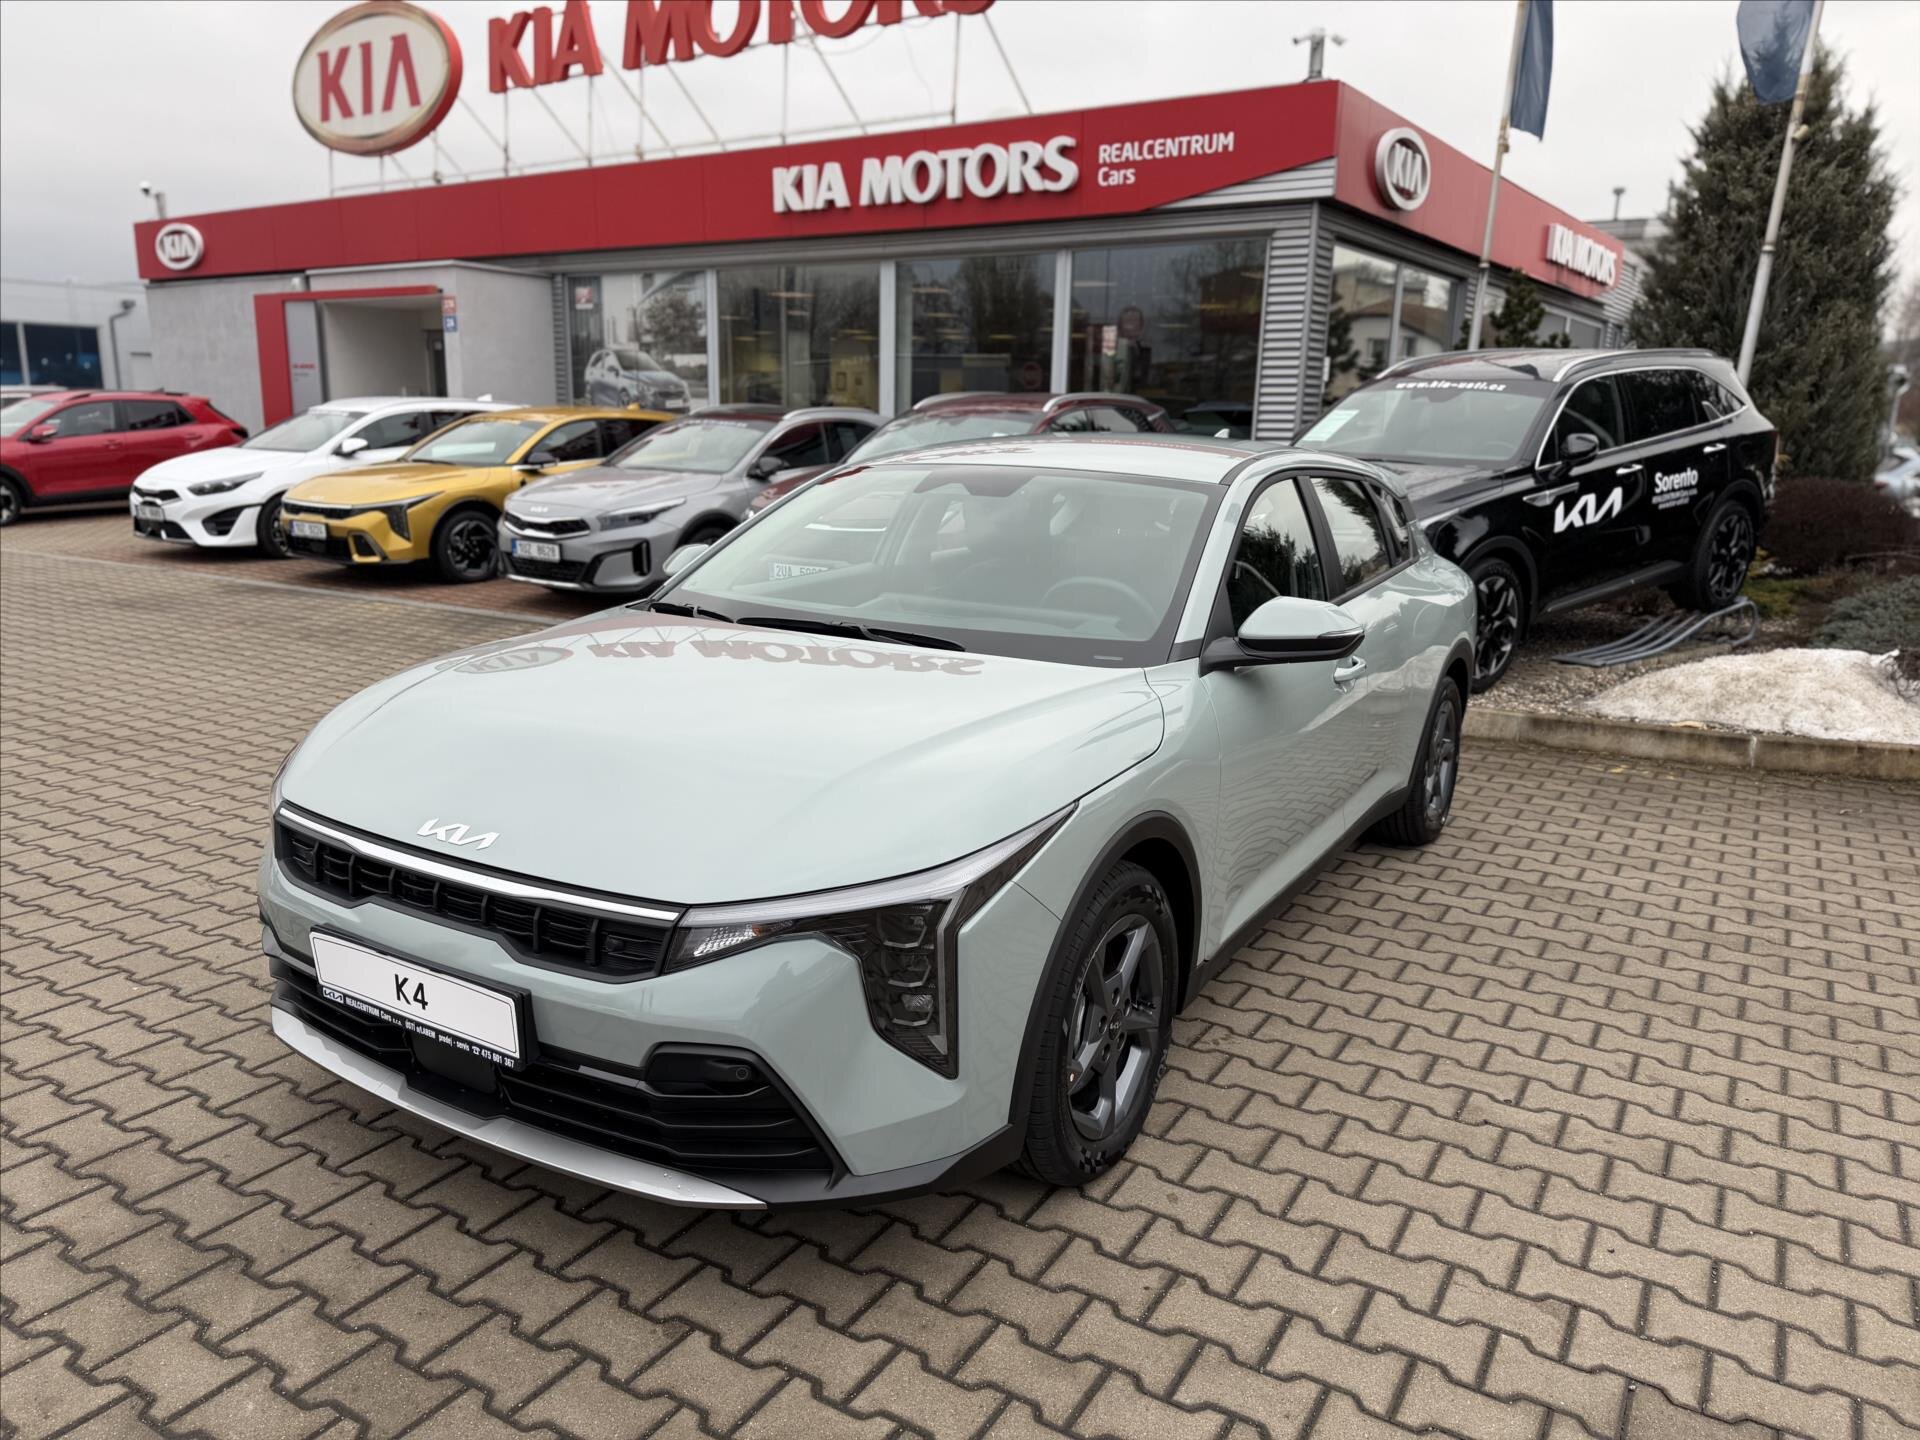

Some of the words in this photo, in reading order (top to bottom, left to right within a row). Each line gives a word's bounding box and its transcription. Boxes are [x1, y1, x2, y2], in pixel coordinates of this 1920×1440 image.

[488, 0, 604, 93] KIA
[622, 0, 996, 70] MOT
[317, 33, 421, 124] KIA
[1098, 131, 1235, 164] REALCENTRUM
[1391, 141, 1423, 195] KIA
[772, 161, 850, 213] KIA
[859, 136, 1079, 207] MOTORS
[1098, 168, 1136, 187] Cars
[163, 234, 193, 259] KIA
[1549, 223, 1574, 268] KIA
[1574, 233, 1617, 287] MOTORS
[1654, 467, 1699, 494] Sorento
[1553, 486, 1623, 534] KIA
[416, 818, 500, 850] KIA
[394, 973, 429, 1011] K4
[345, 997, 381, 1017] REALCENTRUM
[380, 1010, 392, 1022] Cars
[438, 1034, 453, 1047] prodej
[456, 1040, 470, 1051] servis
[481, 1049, 492, 1060] 475
